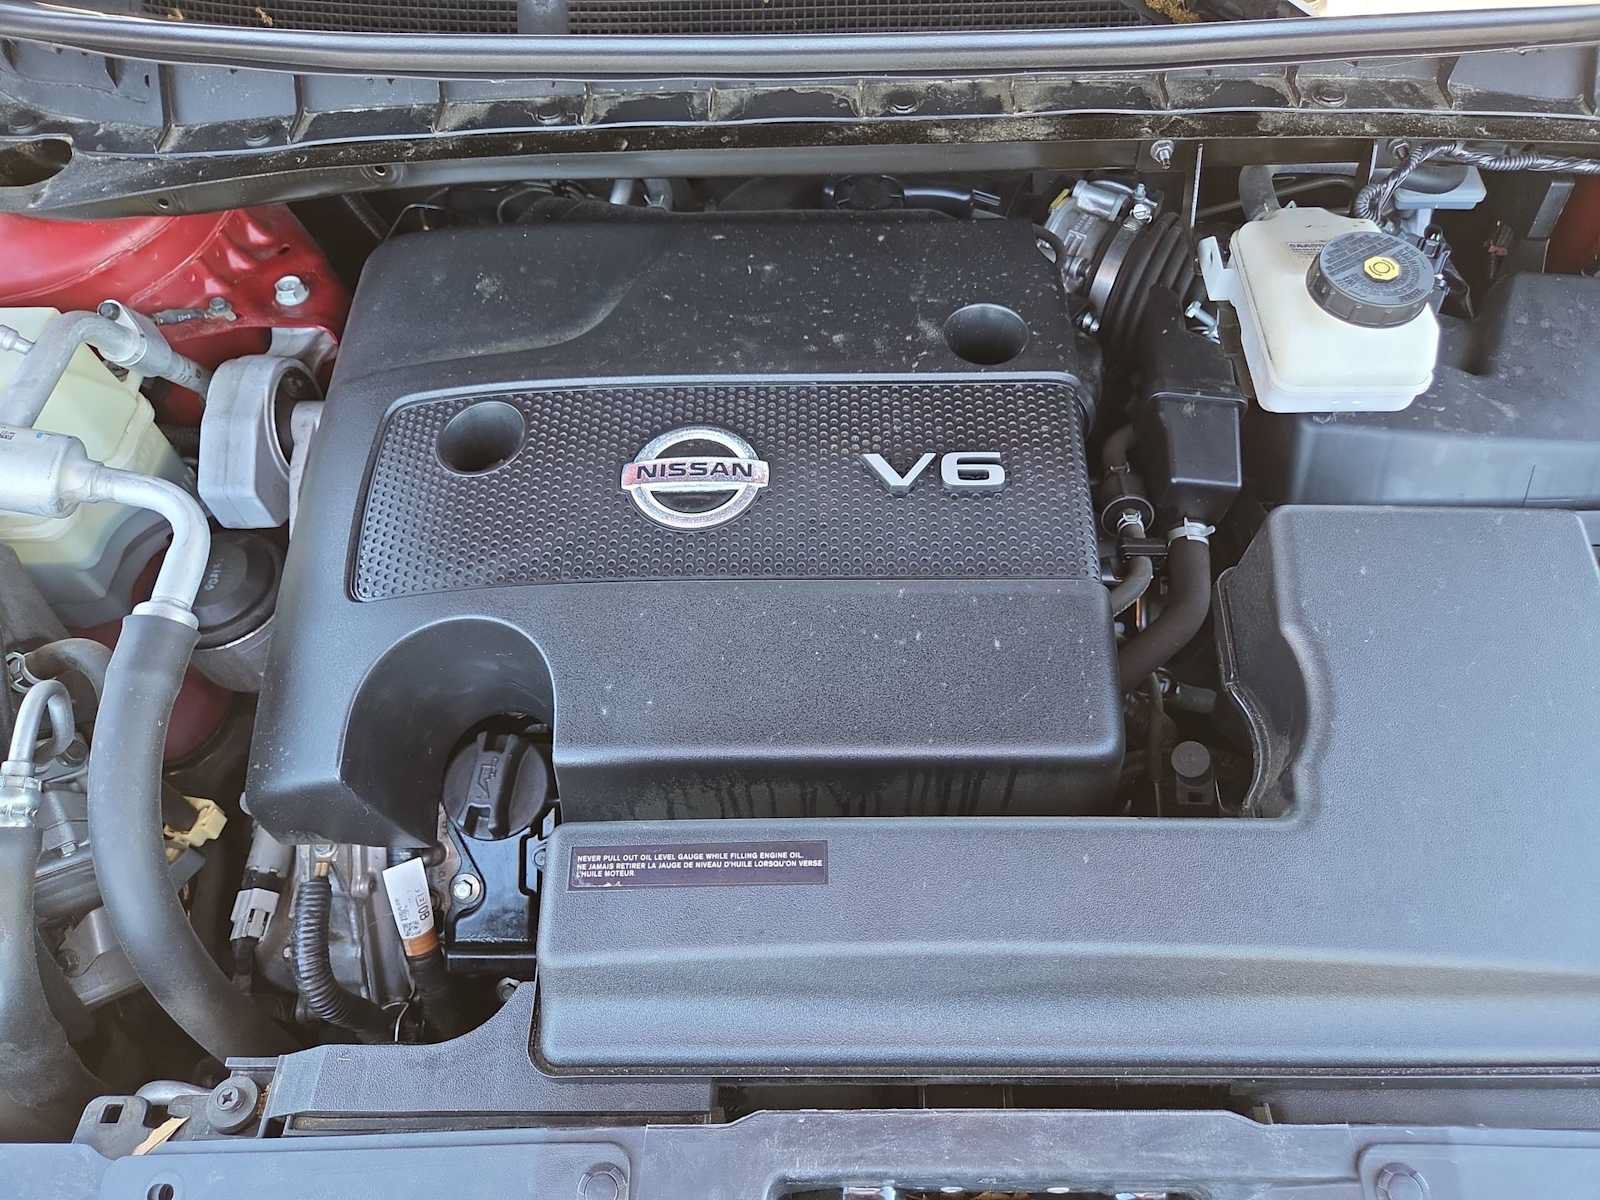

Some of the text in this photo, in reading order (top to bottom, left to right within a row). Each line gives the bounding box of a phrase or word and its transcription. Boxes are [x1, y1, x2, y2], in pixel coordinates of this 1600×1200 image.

[636, 462, 753, 479] NISSAN
[861, 451, 1005, 489] V6
[654, 853, 676, 861] LEVEL
[730, 852, 758, 860] FILLING
[759, 851, 788, 859] ENGINE
[615, 862, 646, 870] RETIRER
[658, 861, 682, 869] JAUGE
[683, 861, 694, 869] DE
[695, 860, 722, 868] NIVEAU
[724, 860, 753, 868] D'HUILE
[754, 859, 797, 868] LORSQU'ON
[798, 859, 823, 867] VERSE
[604, 869, 635, 877] MOTEUR
